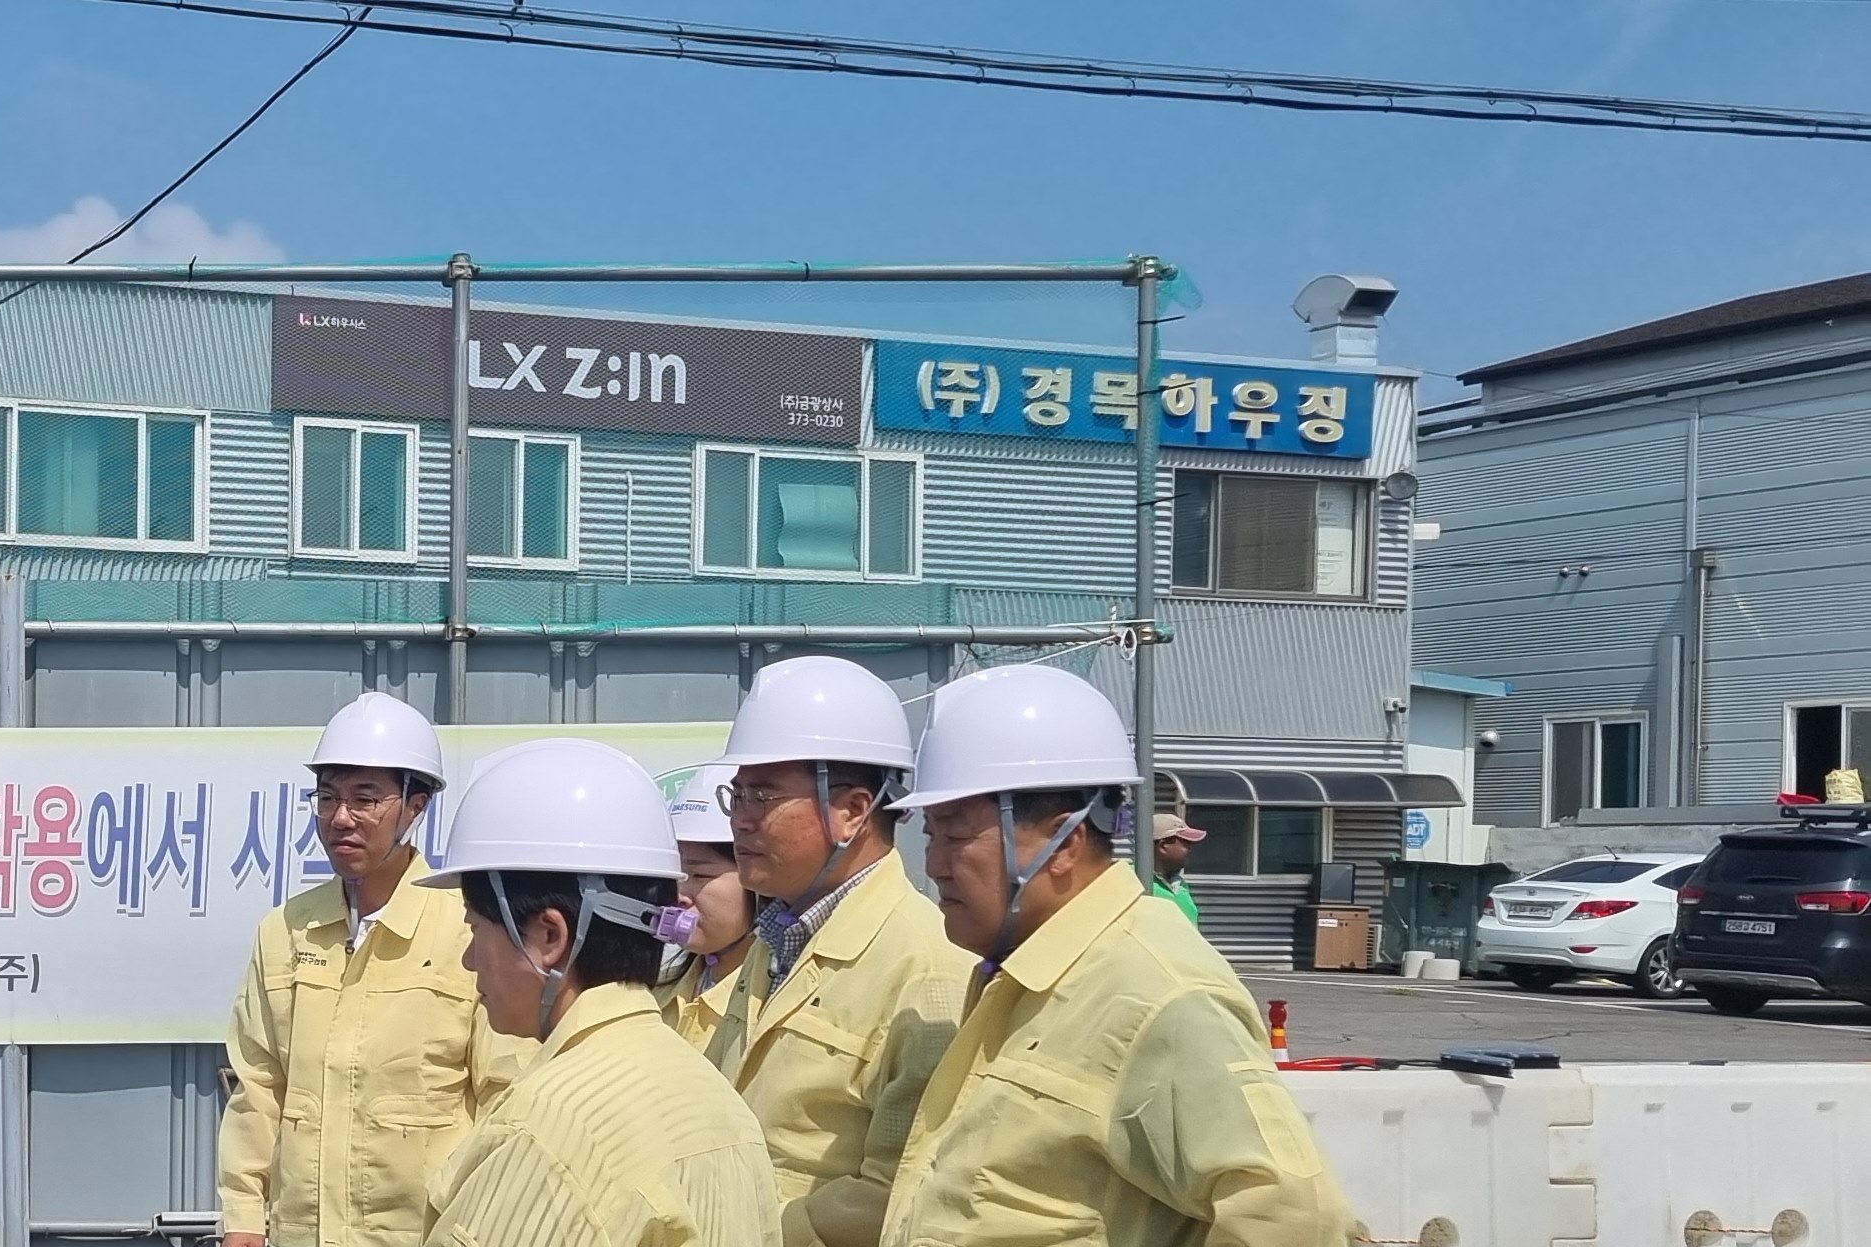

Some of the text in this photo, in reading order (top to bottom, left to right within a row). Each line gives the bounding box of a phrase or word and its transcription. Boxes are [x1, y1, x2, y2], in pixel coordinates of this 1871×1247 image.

[469, 340, 547, 393] LX
[781, 393, 843, 412] (주)금광상사
[788, 412, 843, 428] 373-0230
